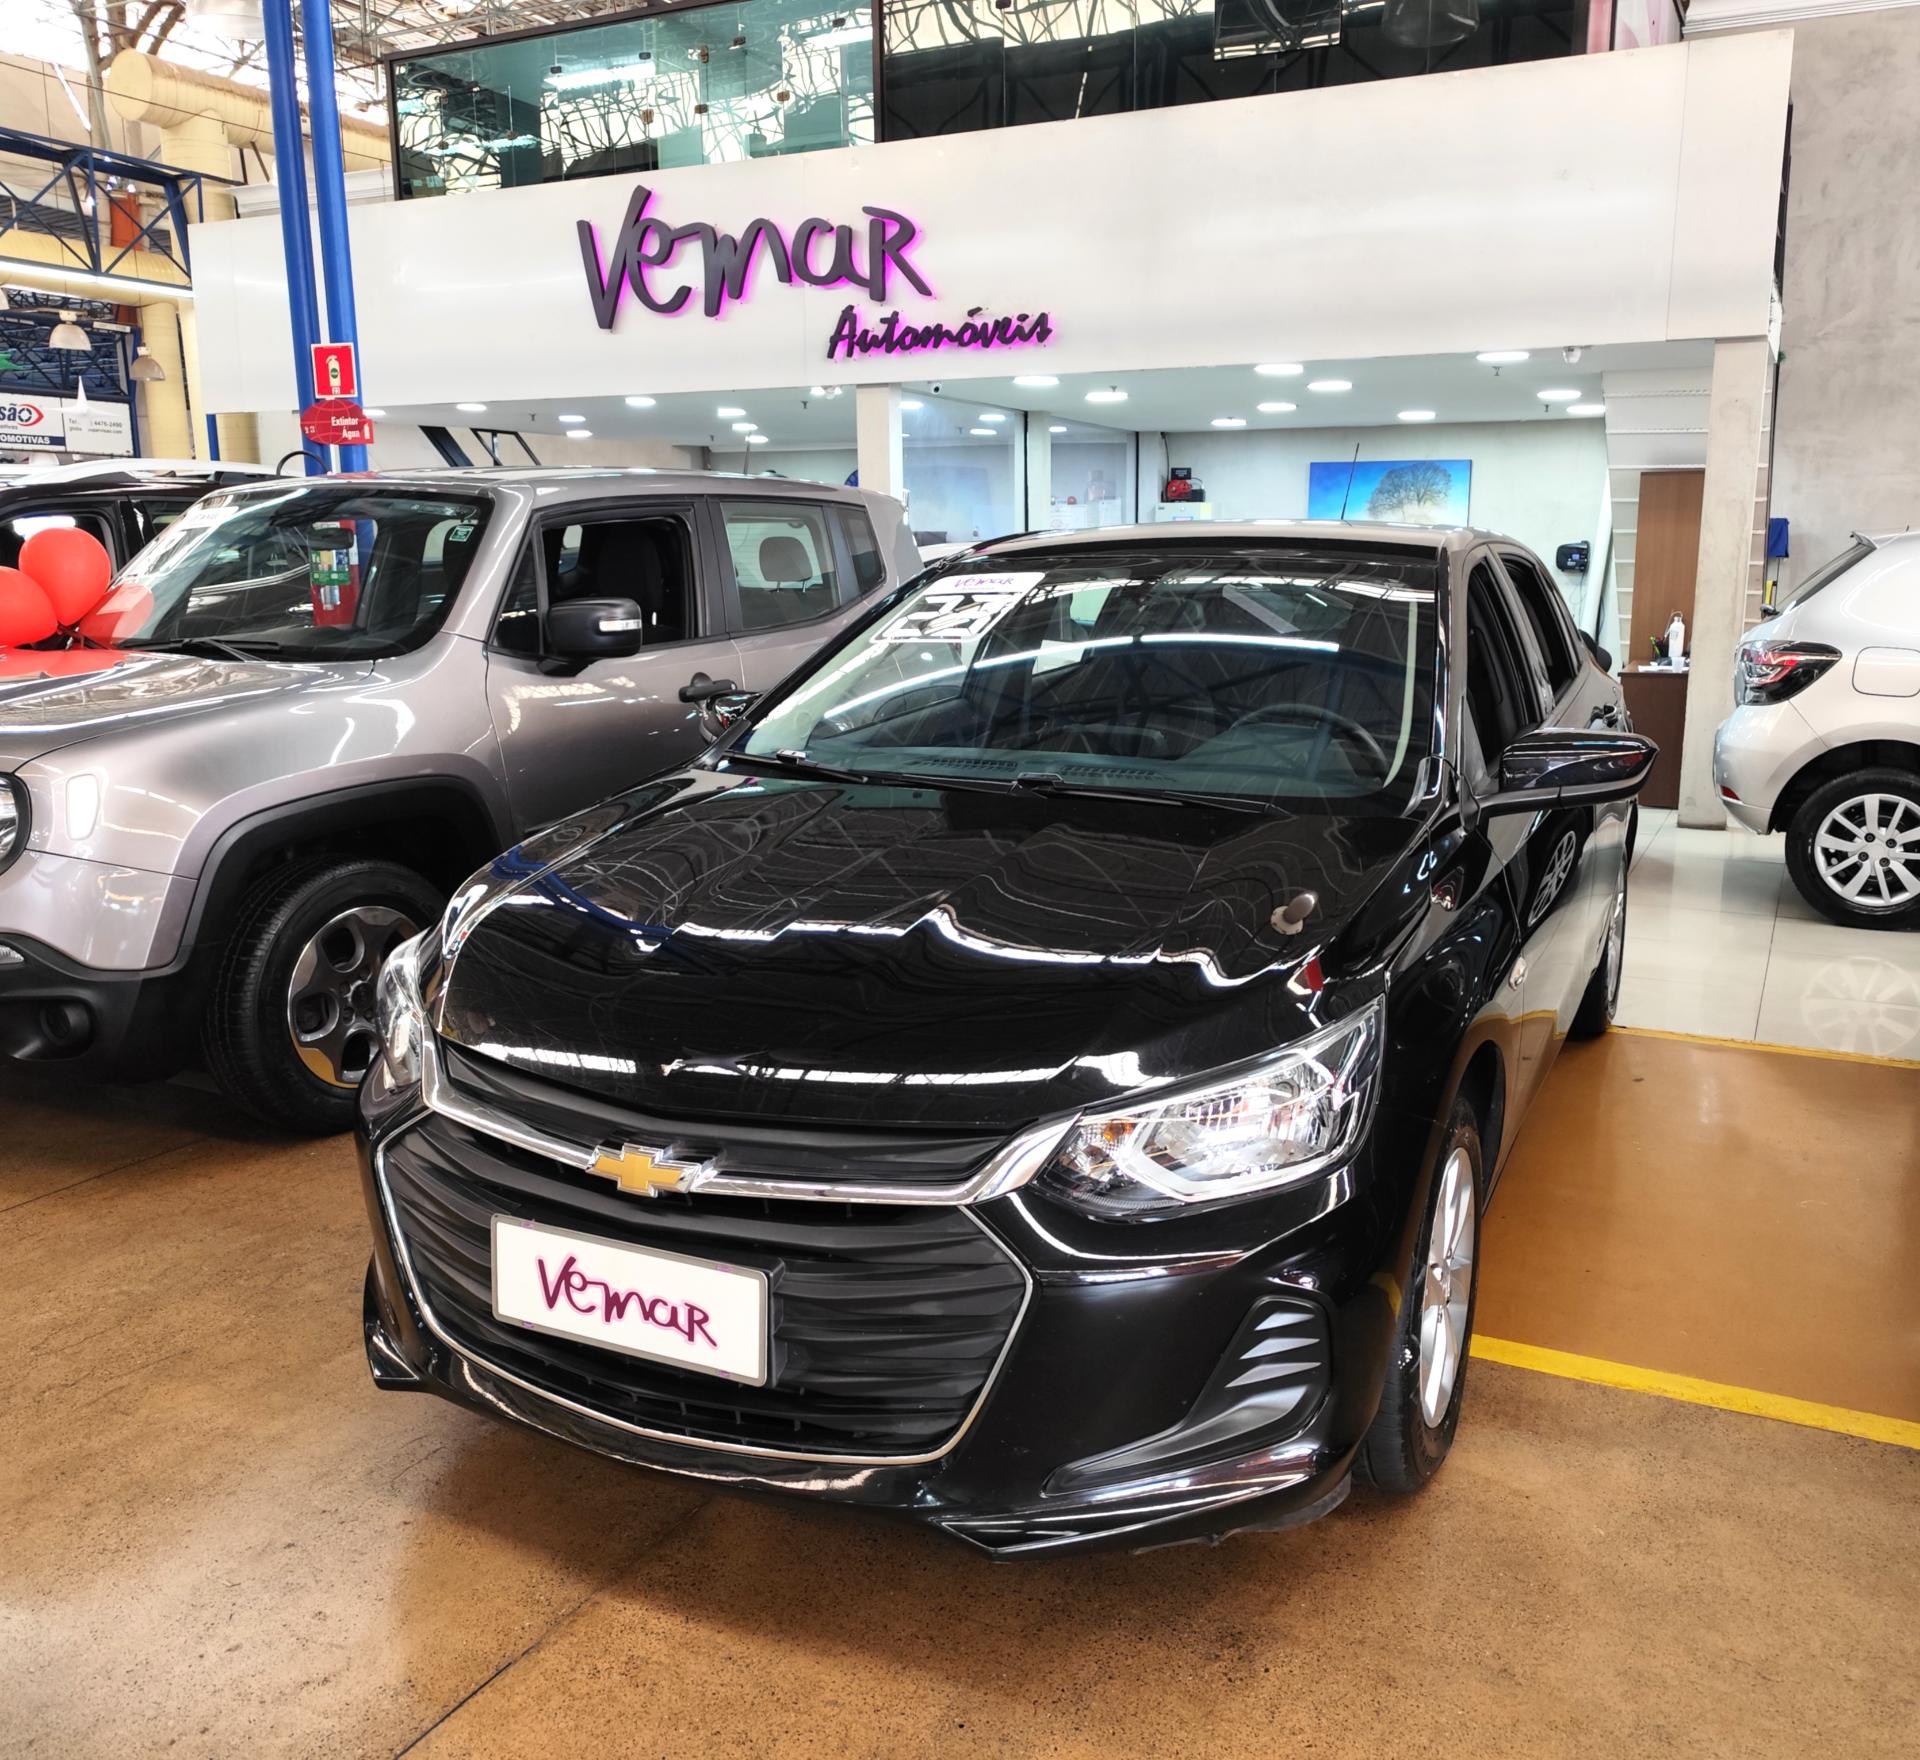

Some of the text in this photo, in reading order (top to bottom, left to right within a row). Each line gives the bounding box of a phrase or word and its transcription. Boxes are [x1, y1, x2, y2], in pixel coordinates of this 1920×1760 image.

[827, 304, 1053, 360] Automóveis
[331, 416, 359, 426] Extintor
[342, 425, 360, 439] Água
